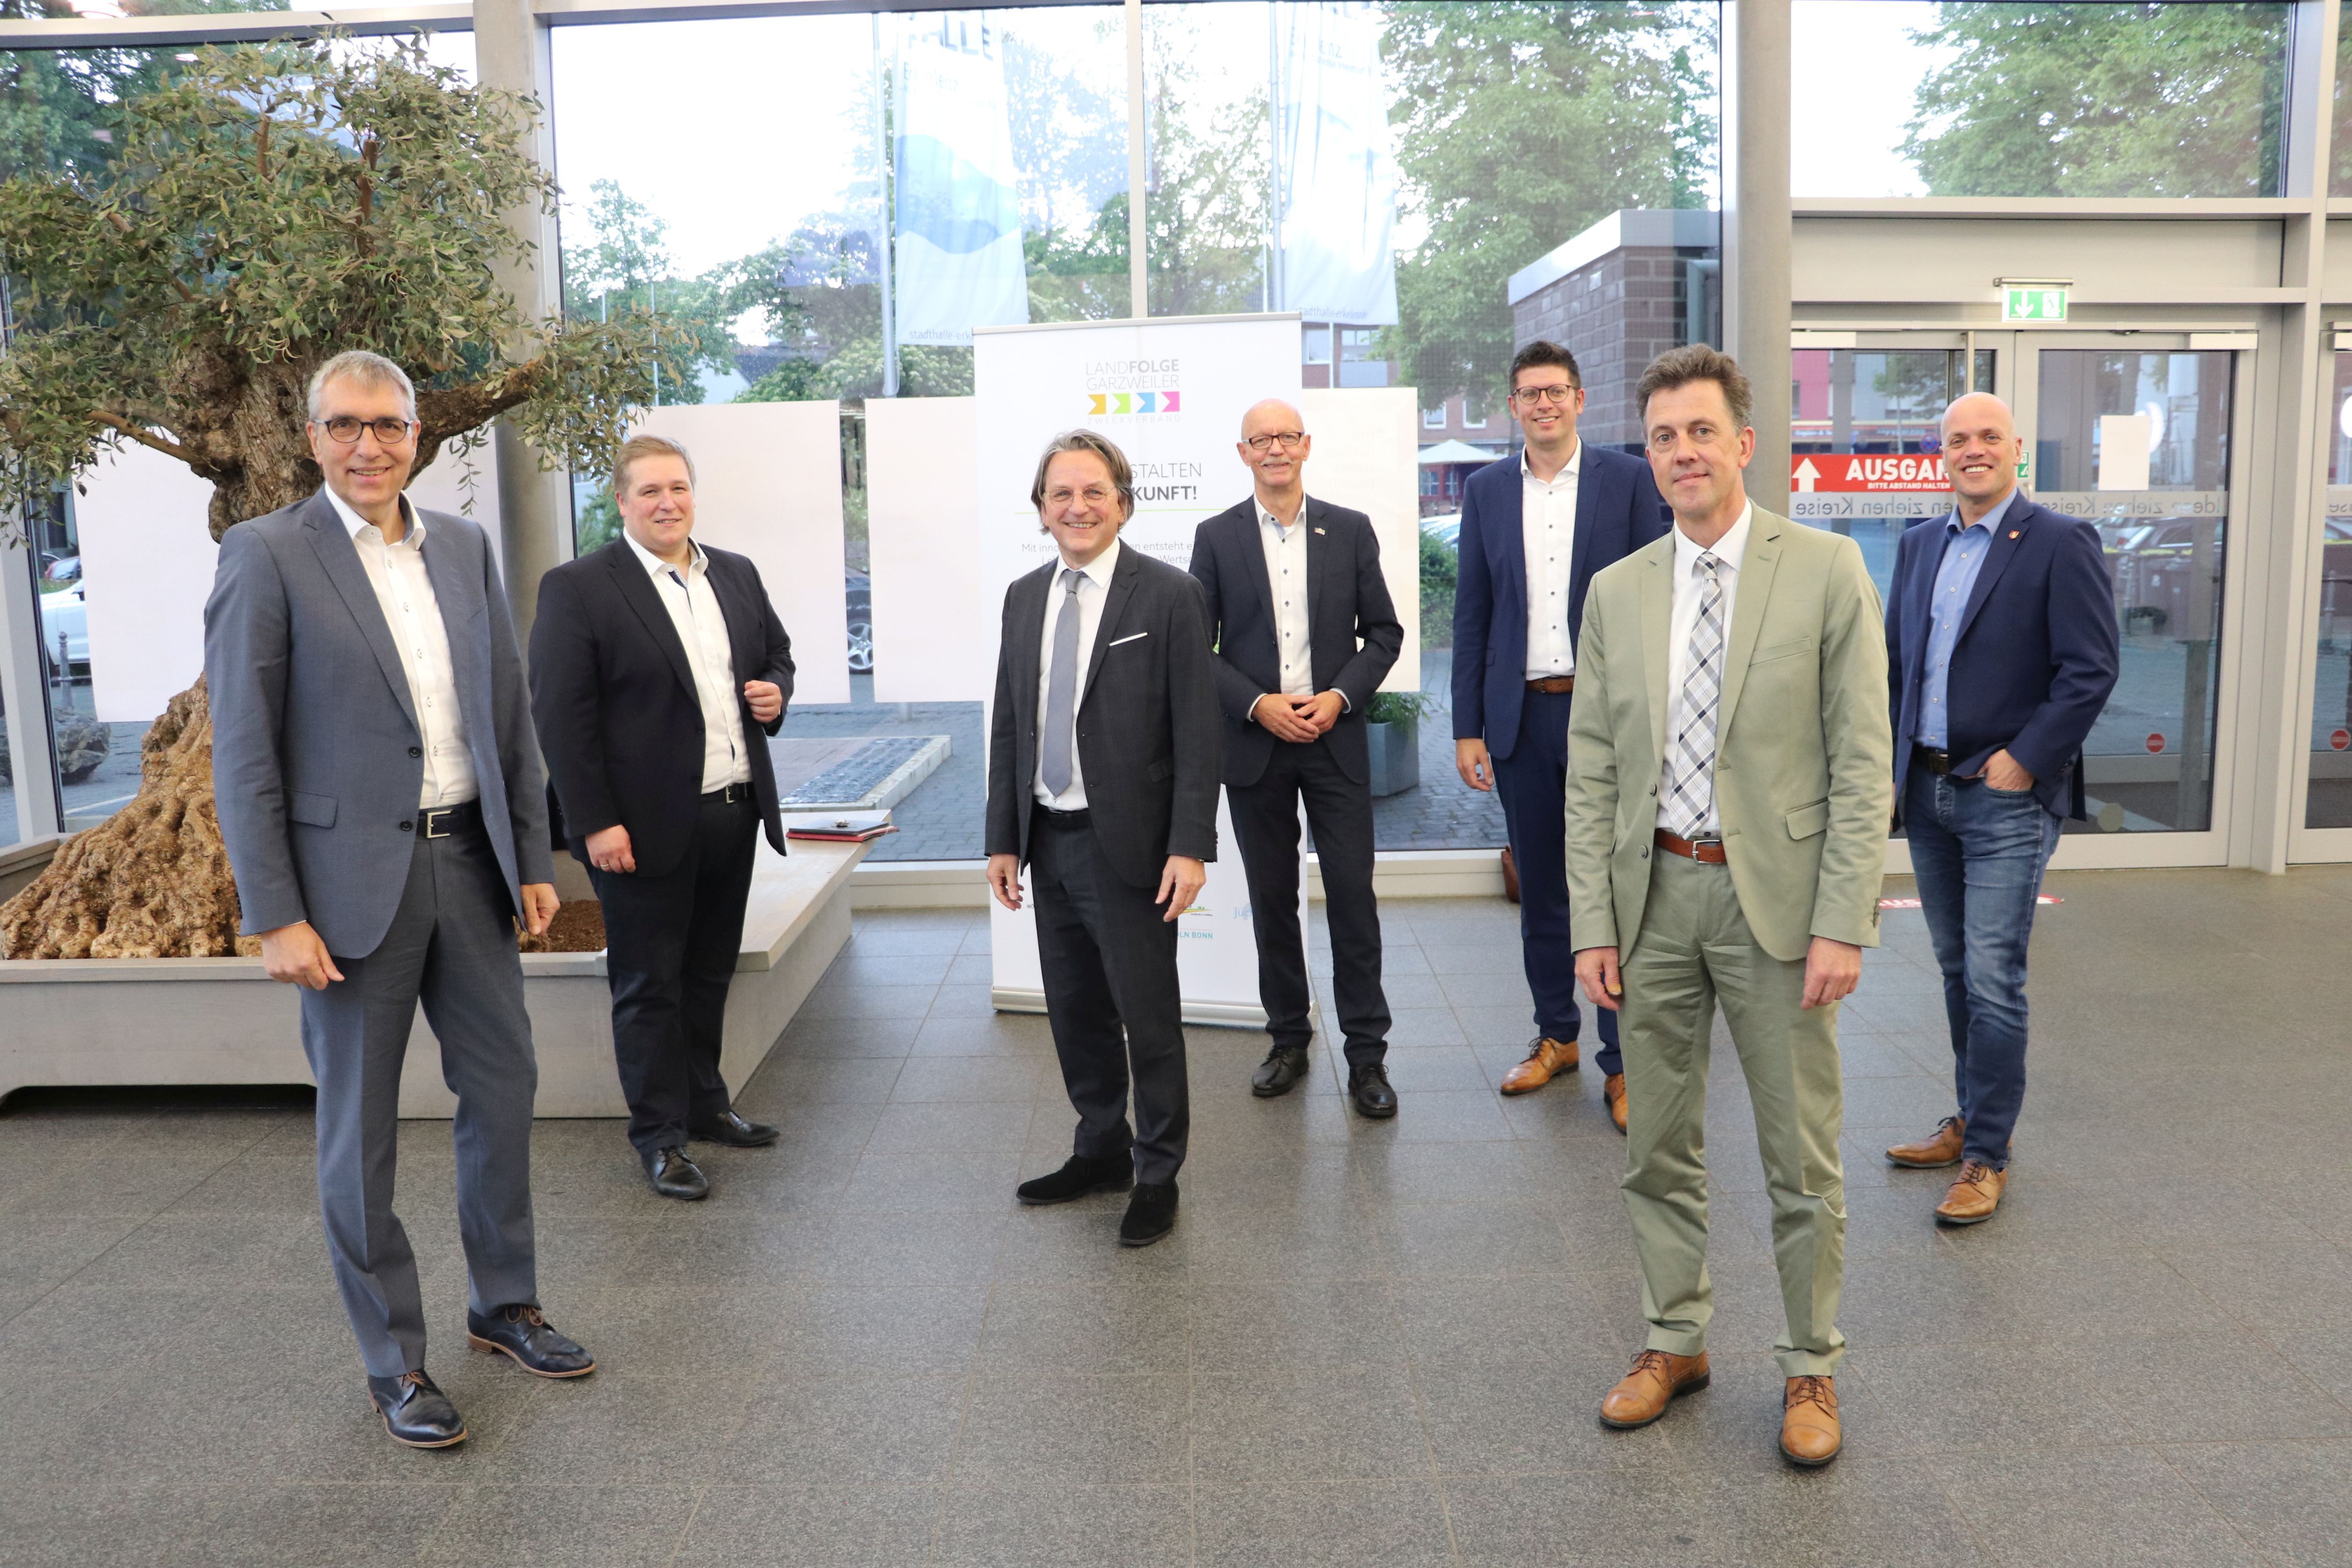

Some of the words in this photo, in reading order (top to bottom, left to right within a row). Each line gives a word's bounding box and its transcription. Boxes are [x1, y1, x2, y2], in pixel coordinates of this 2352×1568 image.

[1086, 359, 1179, 375] LANDFOLGE
[1087, 374, 1180, 390] GARZWEILER
[1087, 414, 1181, 425] ZWECKVERBAND
[1132, 486, 1197, 501] KUNFT!
[1022, 543, 1037, 552] Mit
[1144, 541, 1184, 550] entsteht
